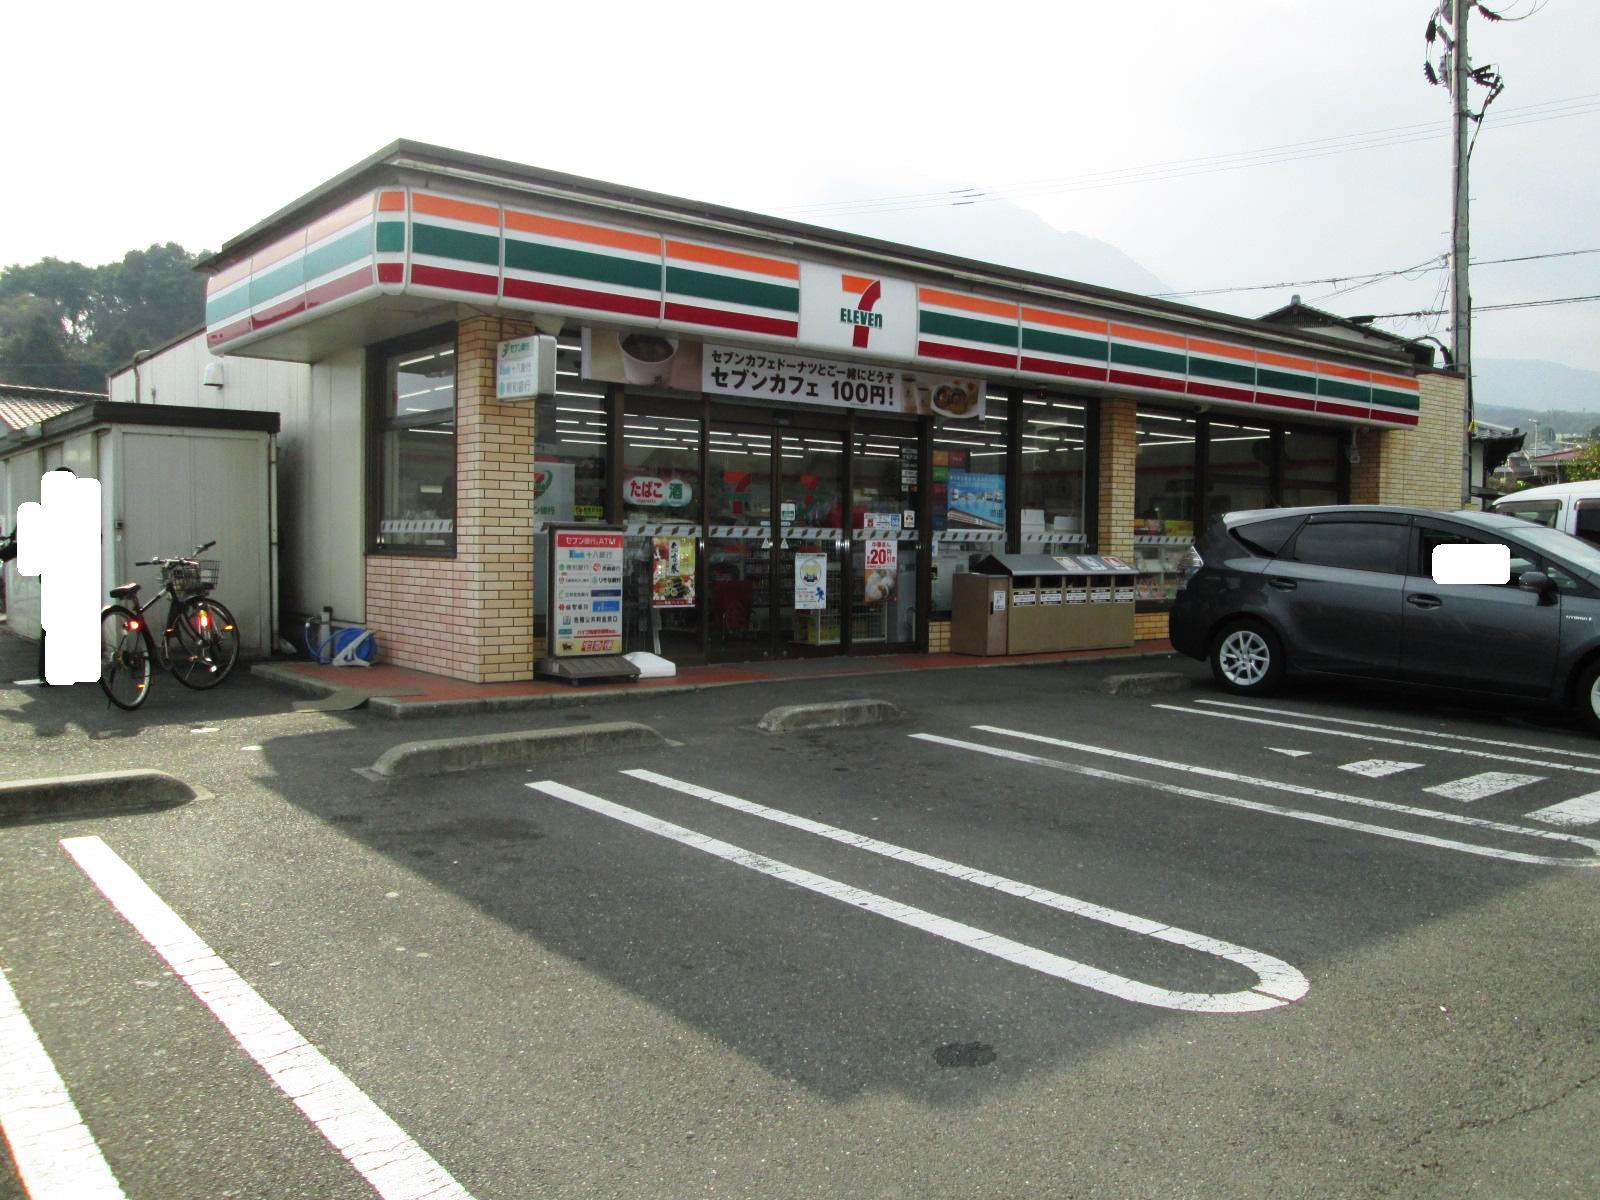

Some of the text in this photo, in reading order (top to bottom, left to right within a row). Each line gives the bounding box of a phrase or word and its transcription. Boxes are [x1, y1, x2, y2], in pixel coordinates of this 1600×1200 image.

[841, 274, 881, 349] 7
[711, 350, 895, 384] セブンカフェドーナツとご一緒にどうぞ
[711, 366, 820, 398] セブンカフェ
[629, 479, 683, 501] たばこ 酒
[870, 549, 886, 565] 20
